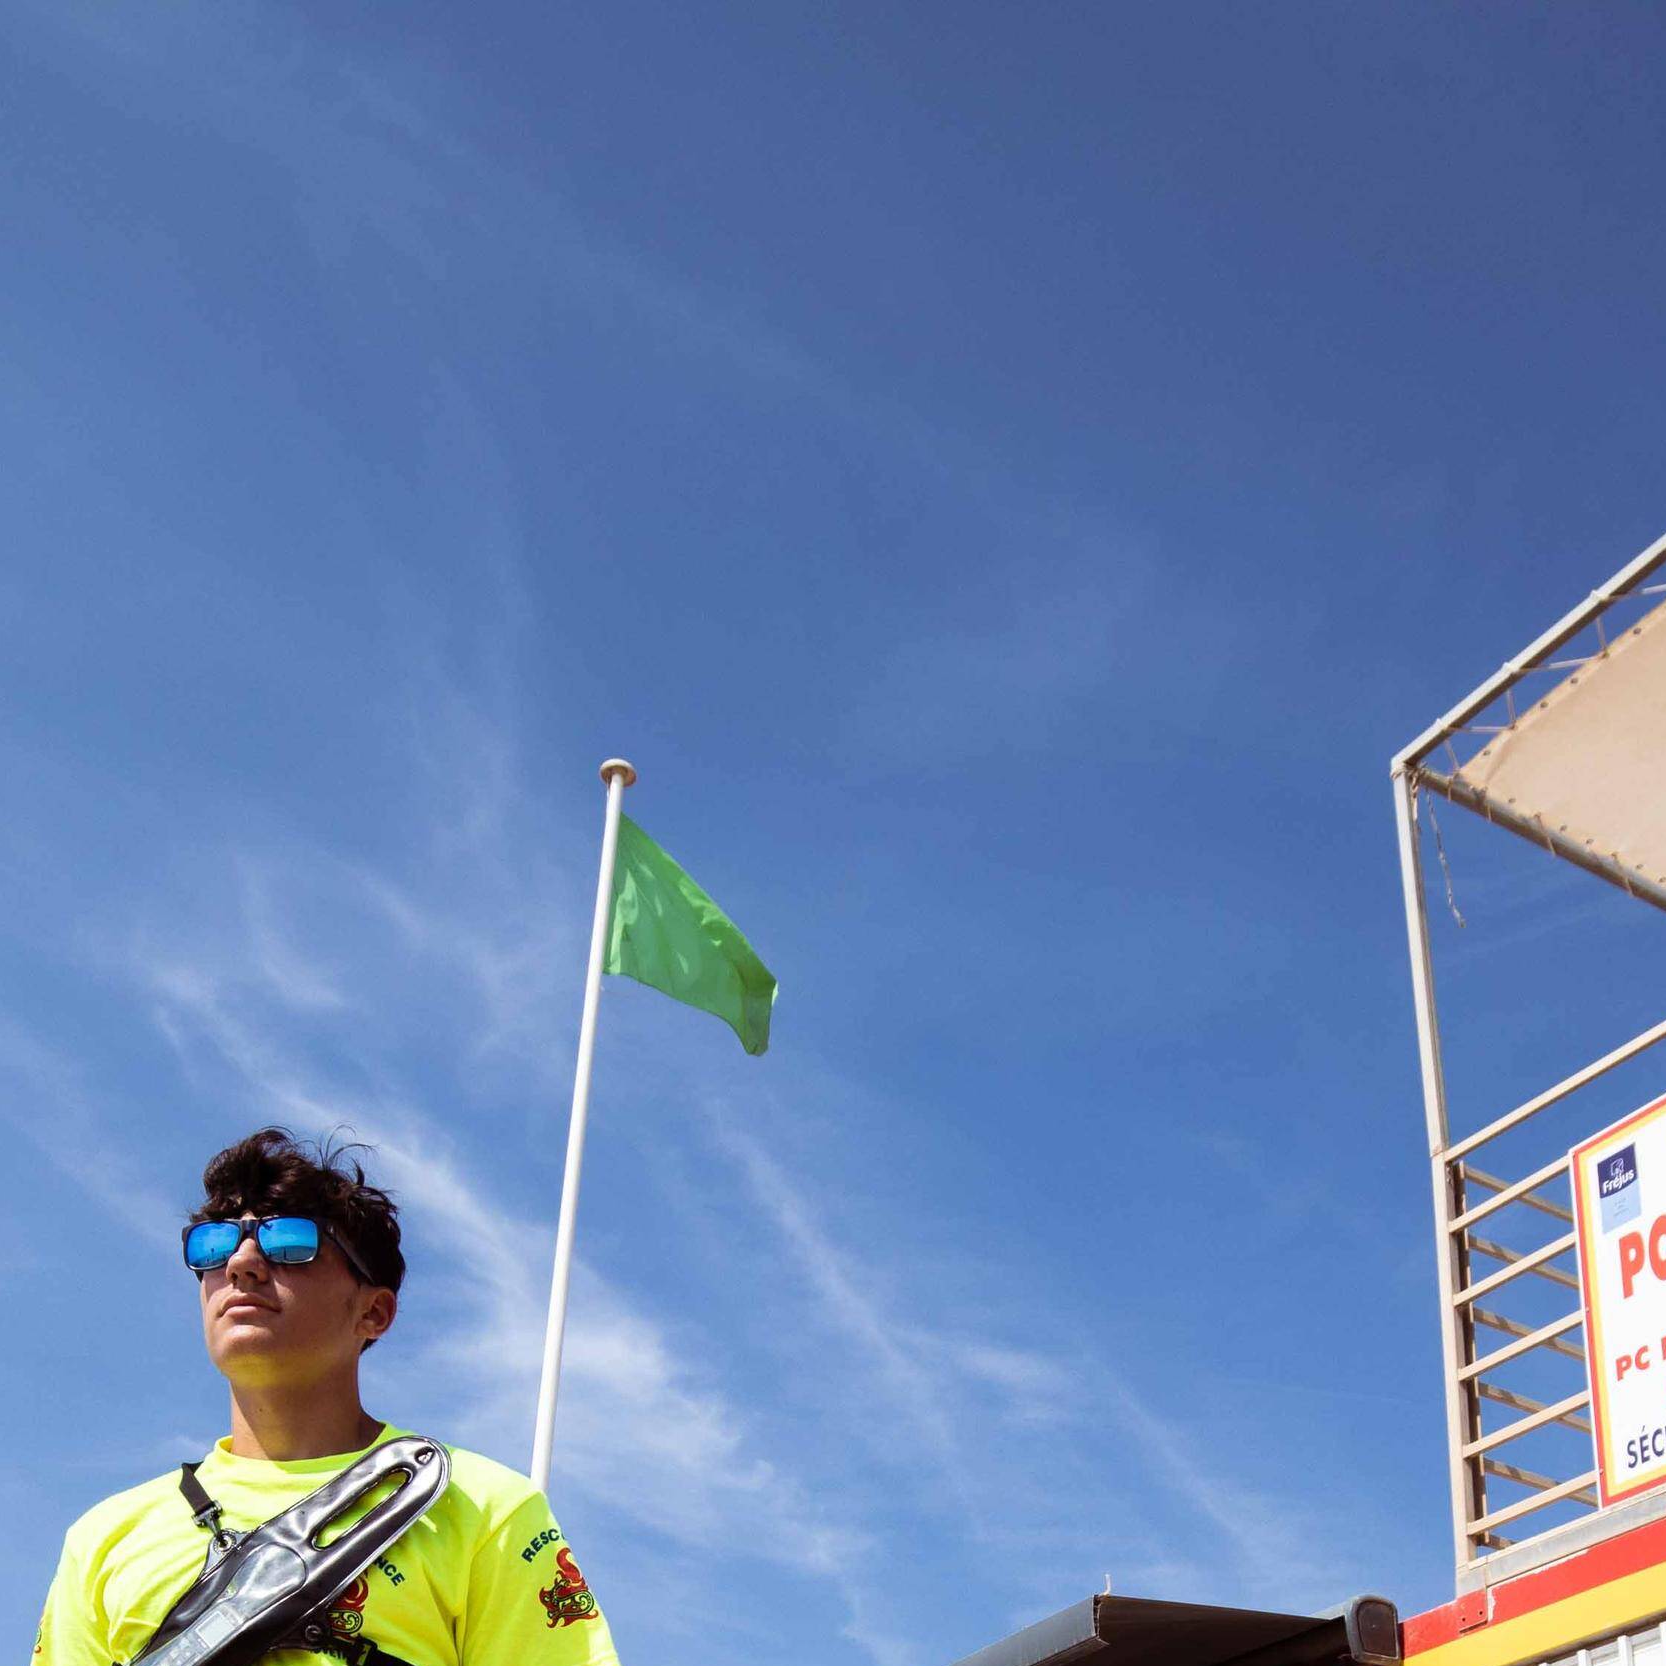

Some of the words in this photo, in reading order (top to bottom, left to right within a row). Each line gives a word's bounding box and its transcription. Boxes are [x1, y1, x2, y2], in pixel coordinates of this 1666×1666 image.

[1602, 1168, 1635, 1195] Fréjus
[1615, 1345, 1651, 1381] PC
[521, 1528, 565, 1563] RESC
